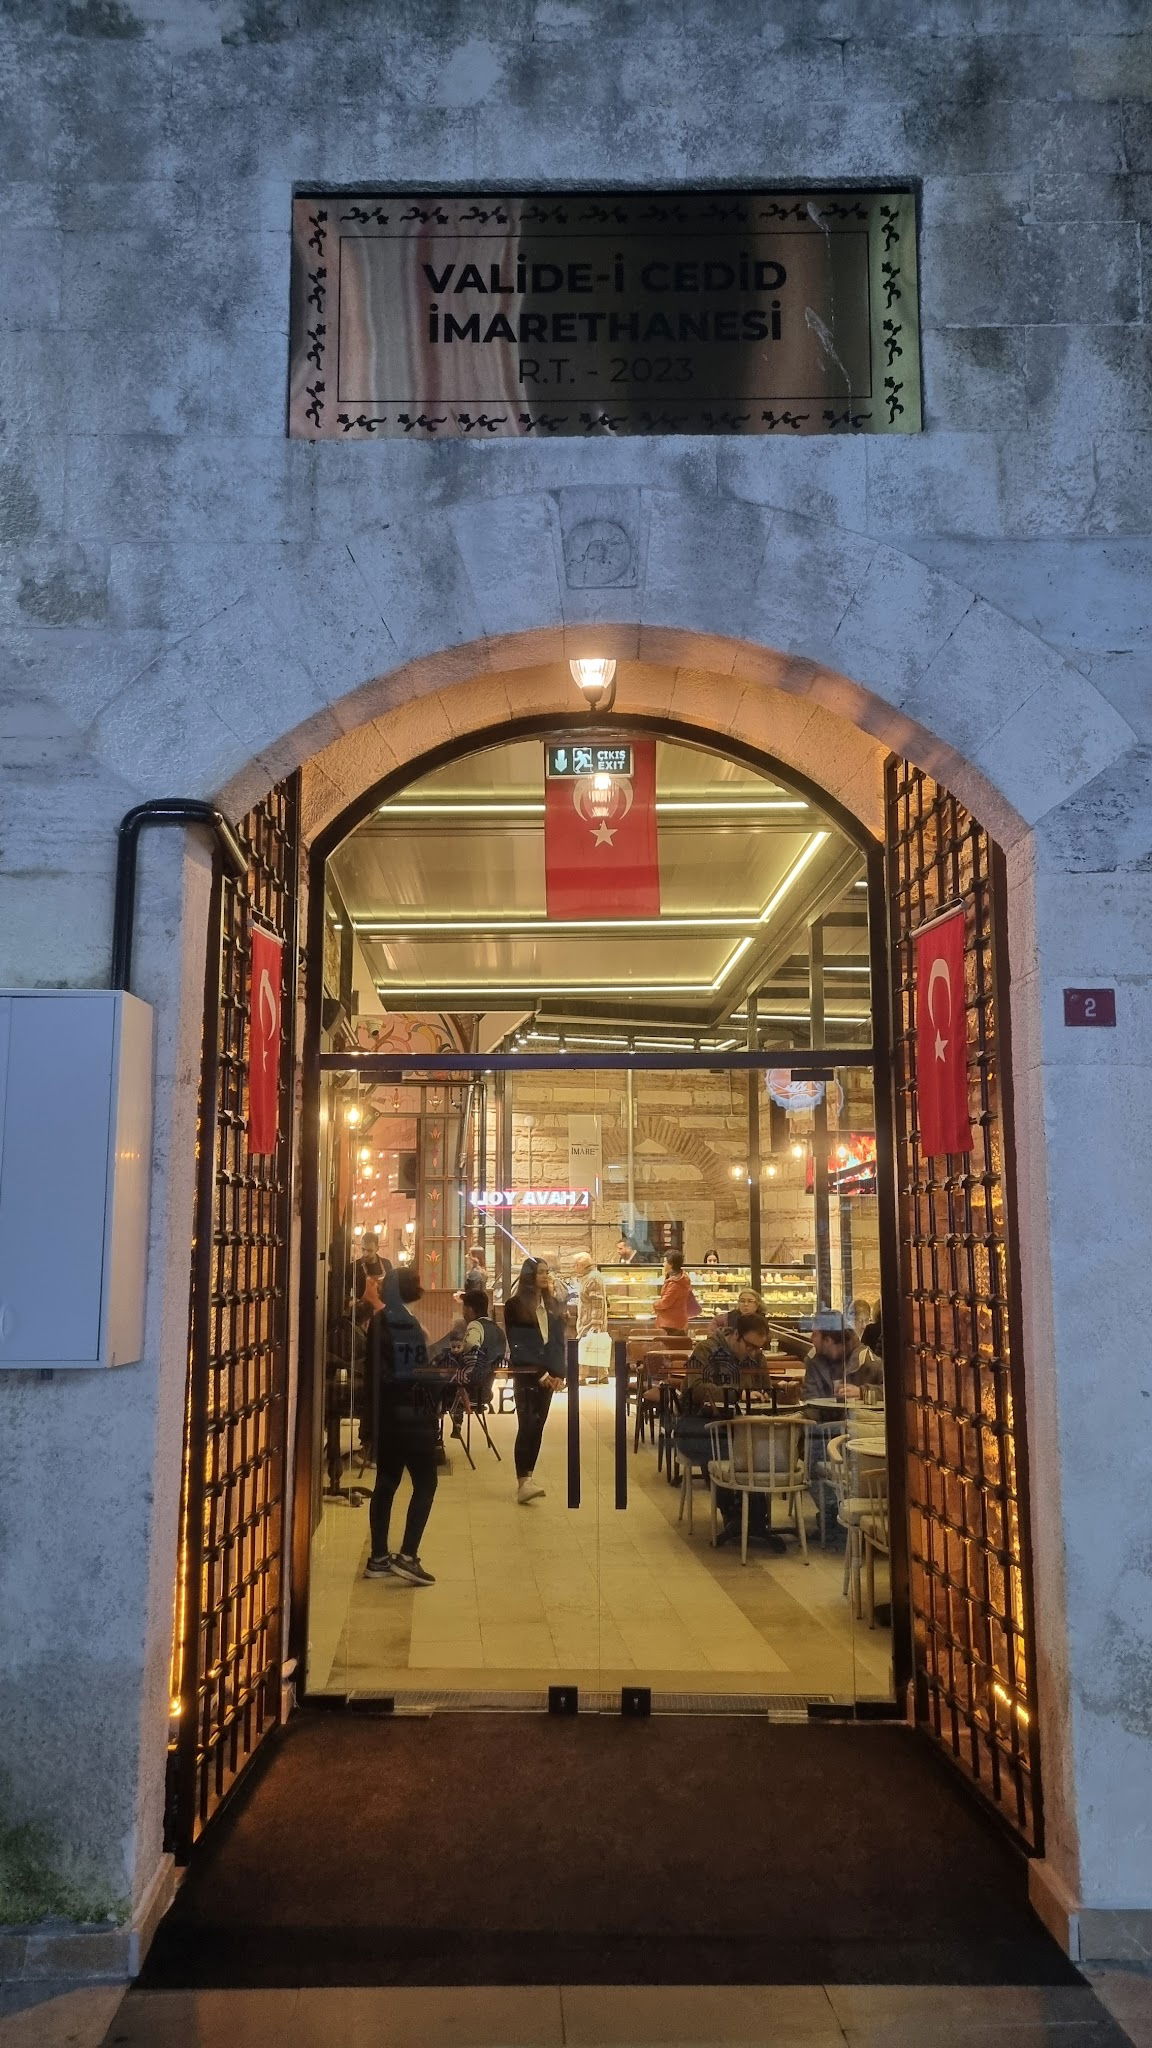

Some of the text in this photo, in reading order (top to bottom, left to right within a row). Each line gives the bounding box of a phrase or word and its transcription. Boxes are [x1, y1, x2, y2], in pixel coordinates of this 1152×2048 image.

[423, 252, 787, 294] VALİDE-İ CEDİD
[429, 300, 782, 344] İMARETHANESİ
[519, 358, 576, 384] R.T.
[610, 357, 694, 383] 2023
[597, 750, 626, 761] ÇIKIŞ
[598, 761, 625, 770] EXIT
[1084, 998, 1097, 1017] 2
